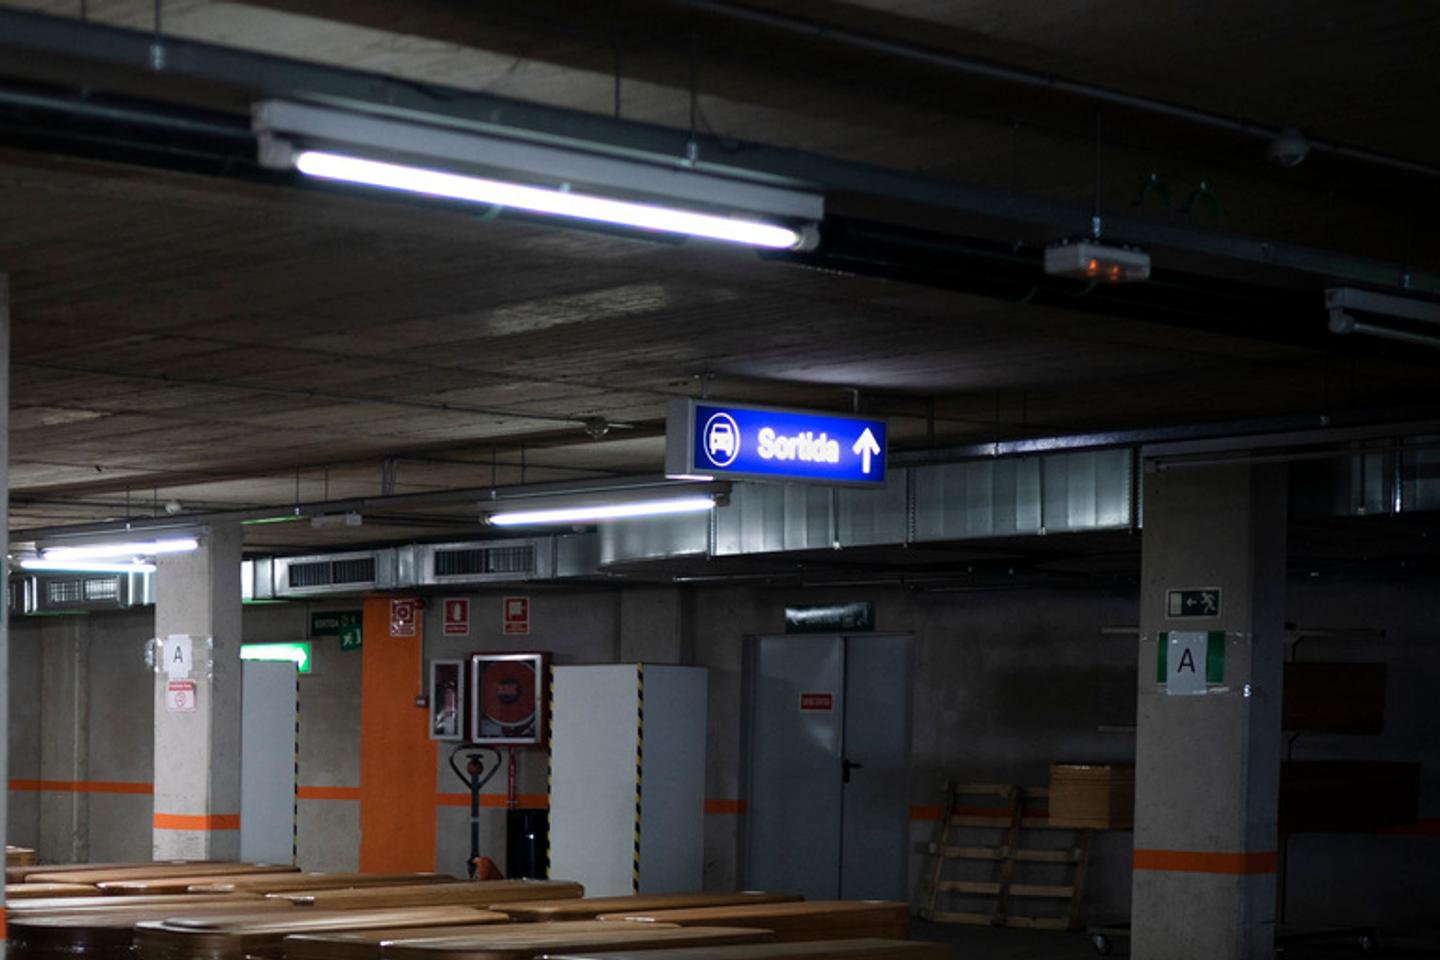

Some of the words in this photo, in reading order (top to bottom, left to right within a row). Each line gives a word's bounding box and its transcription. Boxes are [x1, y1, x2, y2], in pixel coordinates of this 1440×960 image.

[757, 427, 840, 463] Sortida
[173, 645, 184, 663] A
[1177, 648, 1196, 673] A
